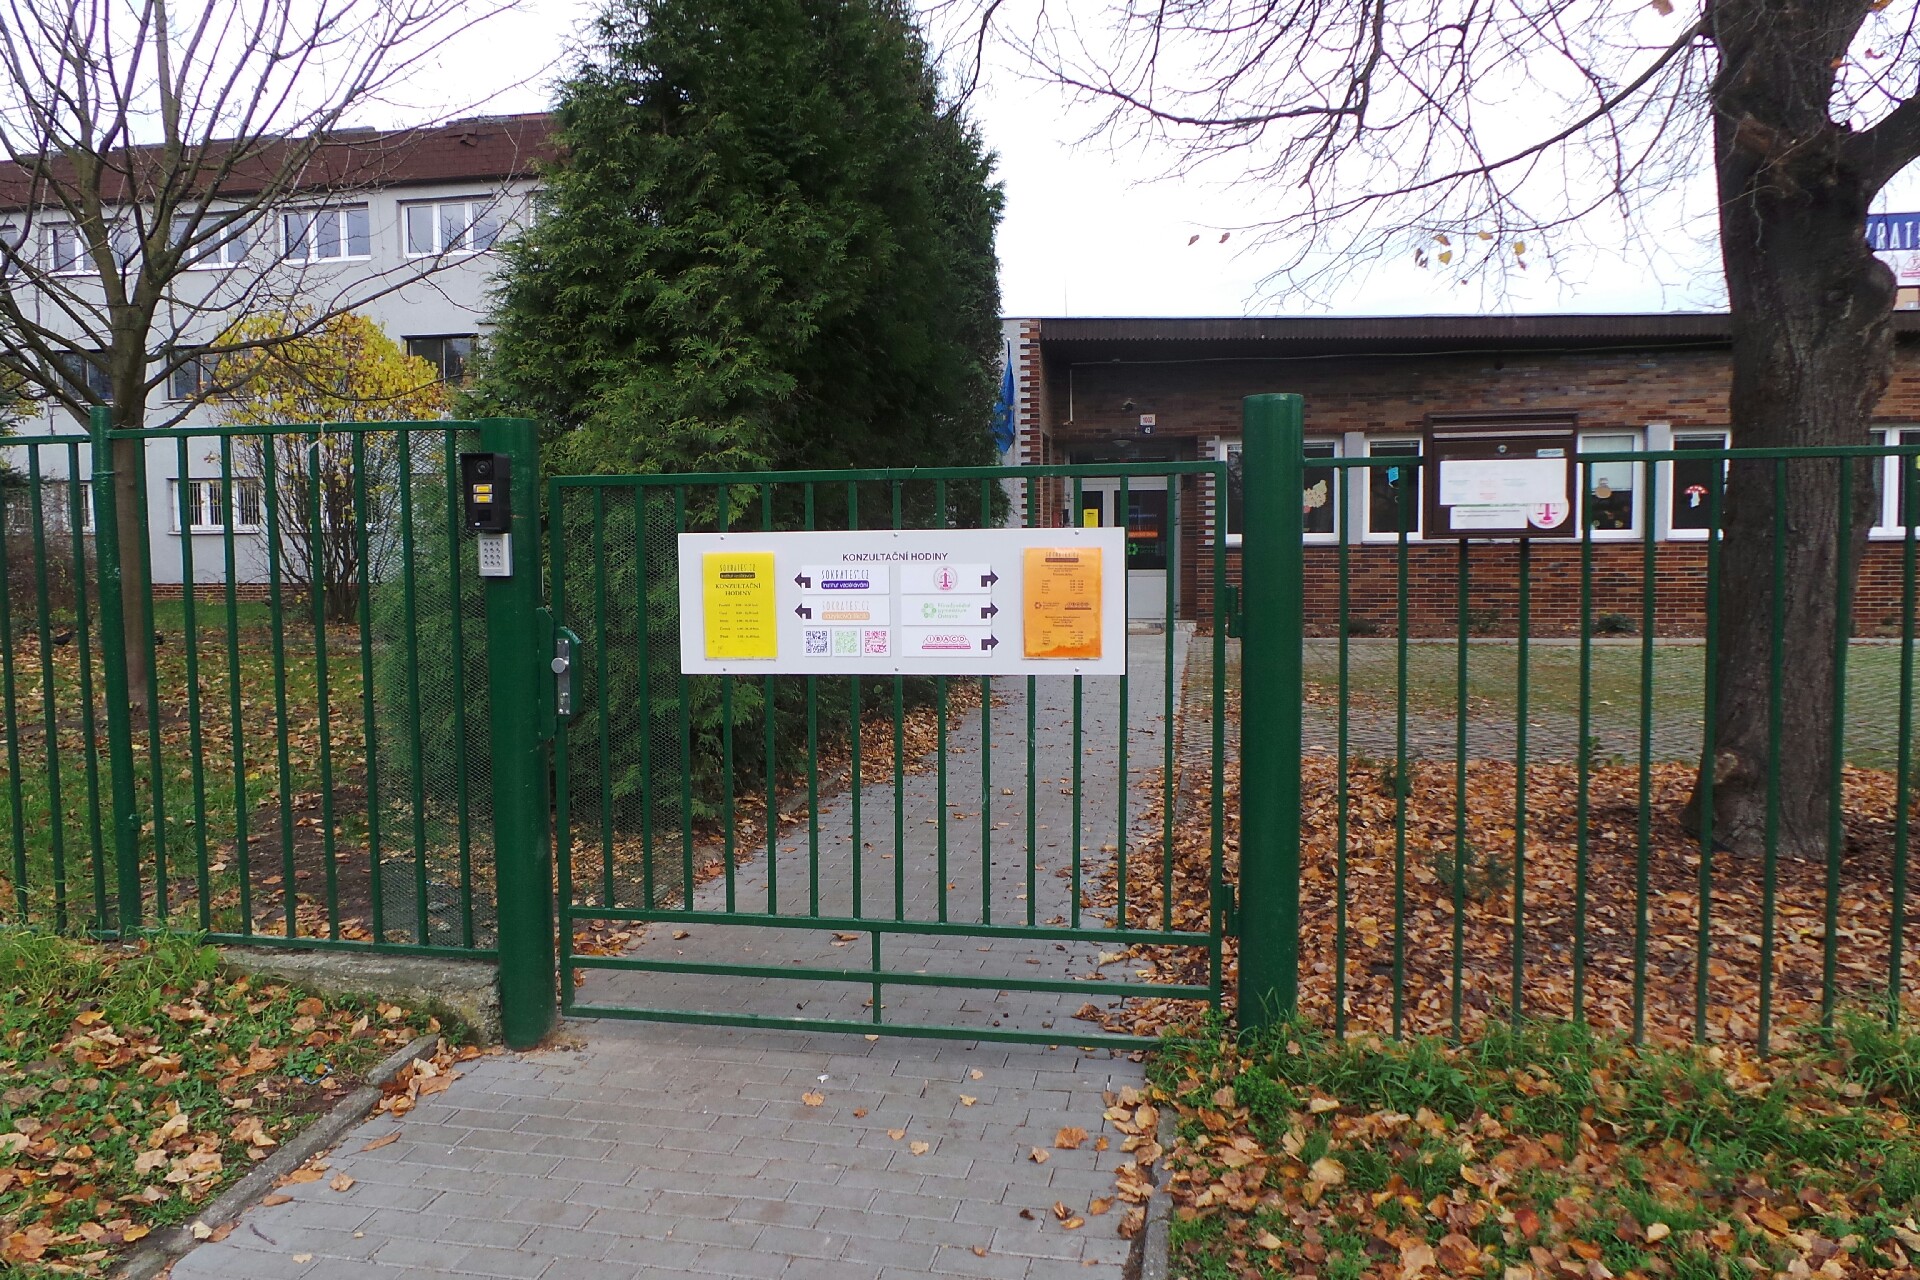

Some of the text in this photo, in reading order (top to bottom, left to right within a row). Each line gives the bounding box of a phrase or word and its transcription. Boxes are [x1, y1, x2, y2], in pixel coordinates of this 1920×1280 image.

[842, 551, 948, 561] KONZULTAČNÍ HODINY
[928, 635, 966, 643] IBACO
